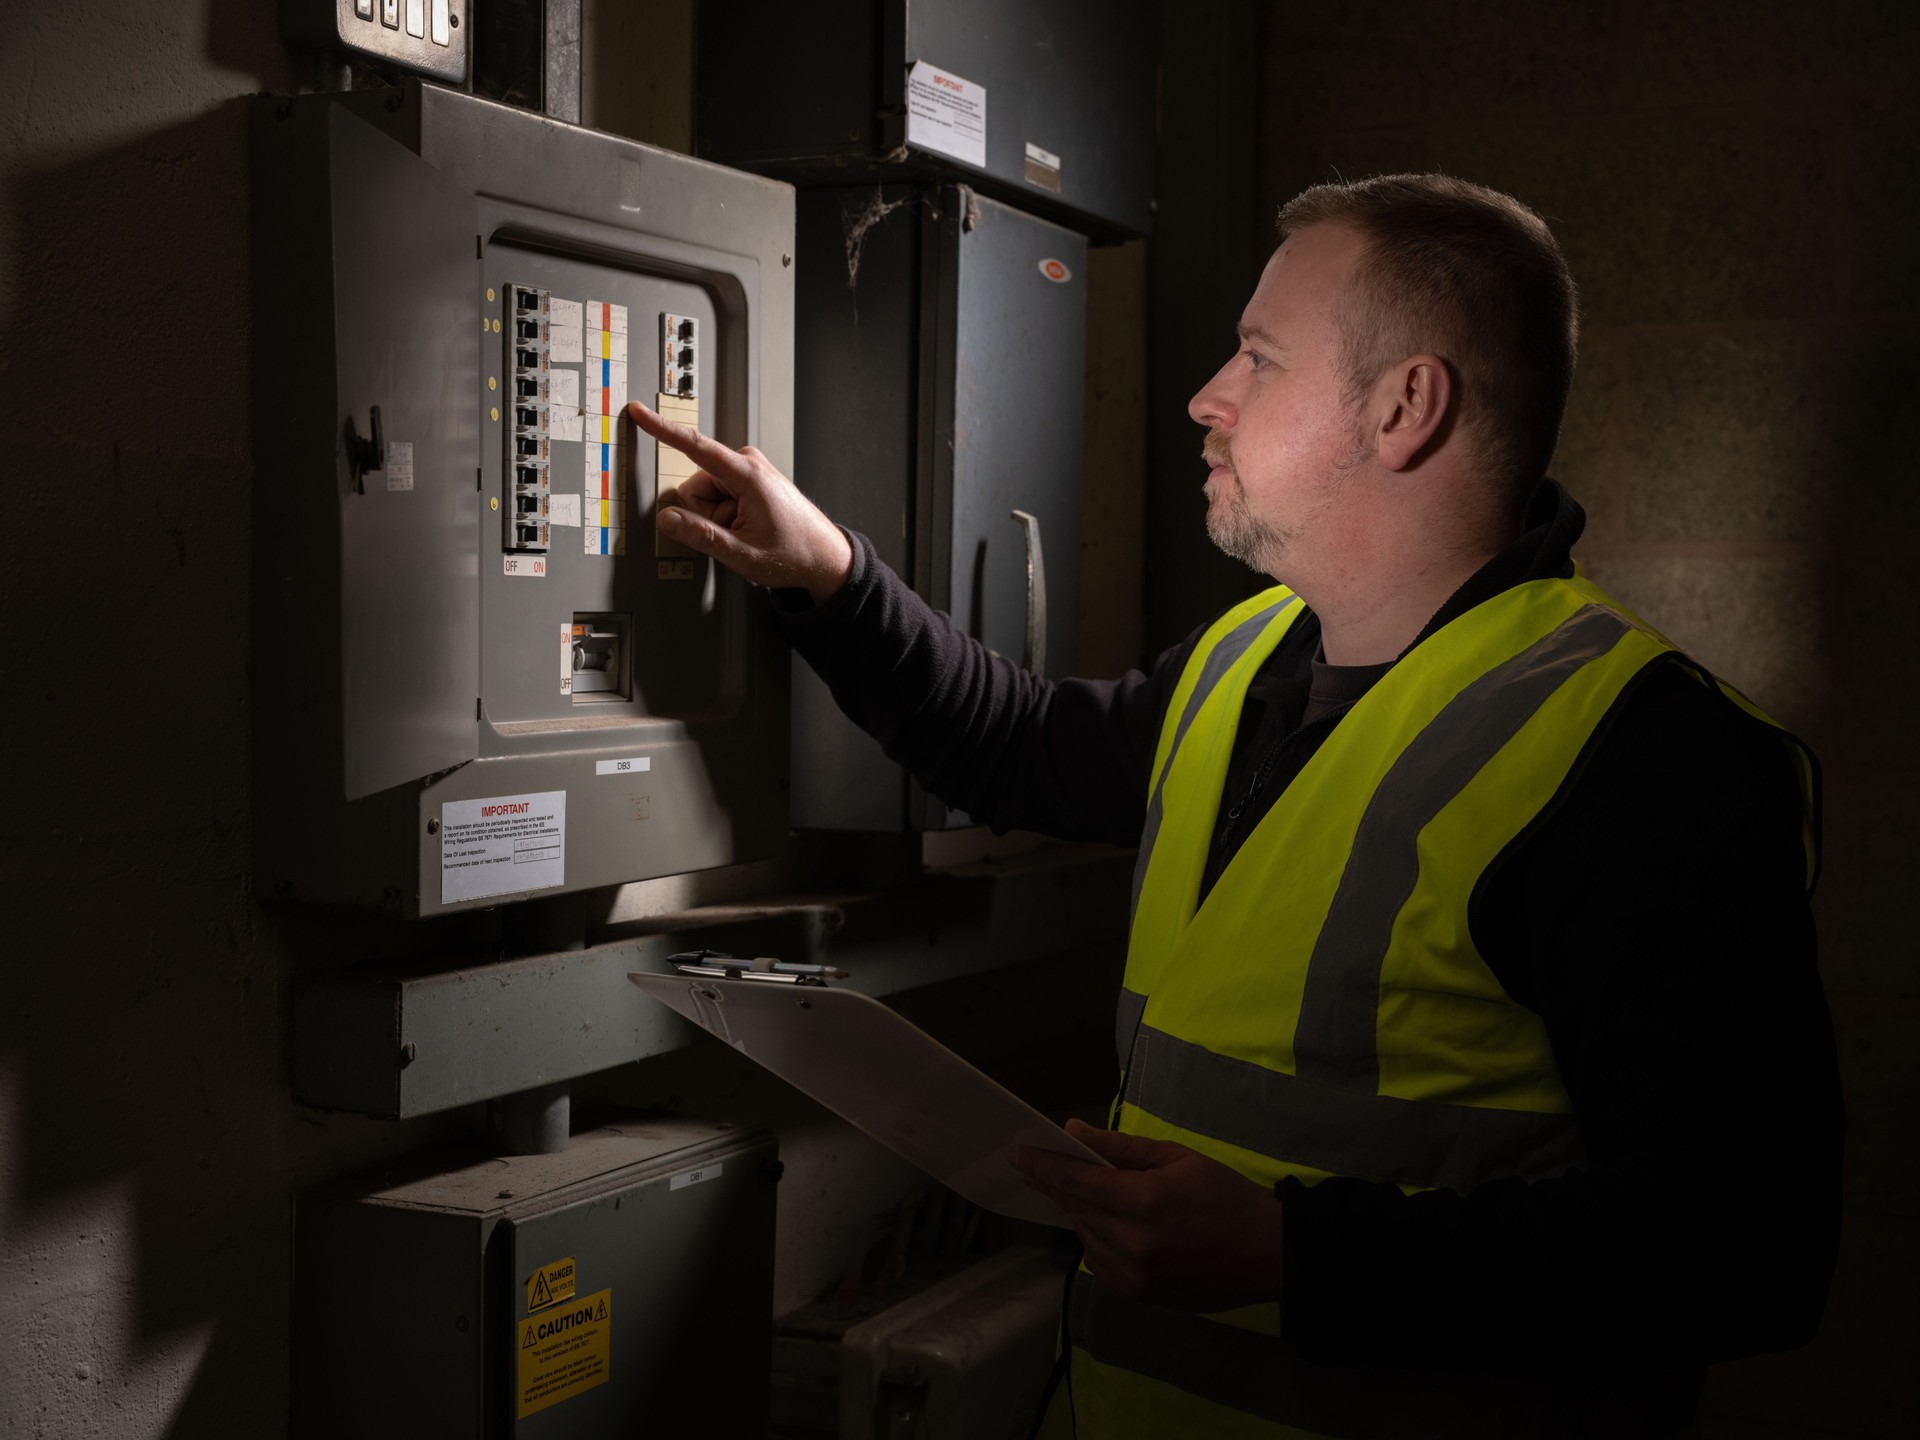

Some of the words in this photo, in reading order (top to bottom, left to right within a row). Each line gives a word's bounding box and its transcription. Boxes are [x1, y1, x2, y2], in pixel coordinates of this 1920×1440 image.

[506, 560, 518, 572] OFF
[534, 562, 544, 573] ON
[660, 565, 669, 575] ON
[682, 565, 691, 575] OFF
[562, 633, 570, 643] ON
[560, 678, 571, 689] OFF
[617, 762, 630, 770] DB3
[481, 803, 529, 817] IMPORTANT
[690, 1171, 702, 1182] DB1
[550, 1265, 573, 1283] DANGER
[559, 1280, 573, 1290] VOLTS
[538, 1306, 593, 1340] CAUTION
[542, 1342, 562, 1353] installation
[552, 1349, 568, 1359] versions
[554, 1366, 567, 1374] should
[525, 1382, 548, 1395] undertaking
[570, 1366, 587, 1376] alteration
[539, 1386, 561, 1398] conductors
[568, 1375, 584, 1385] correctly
